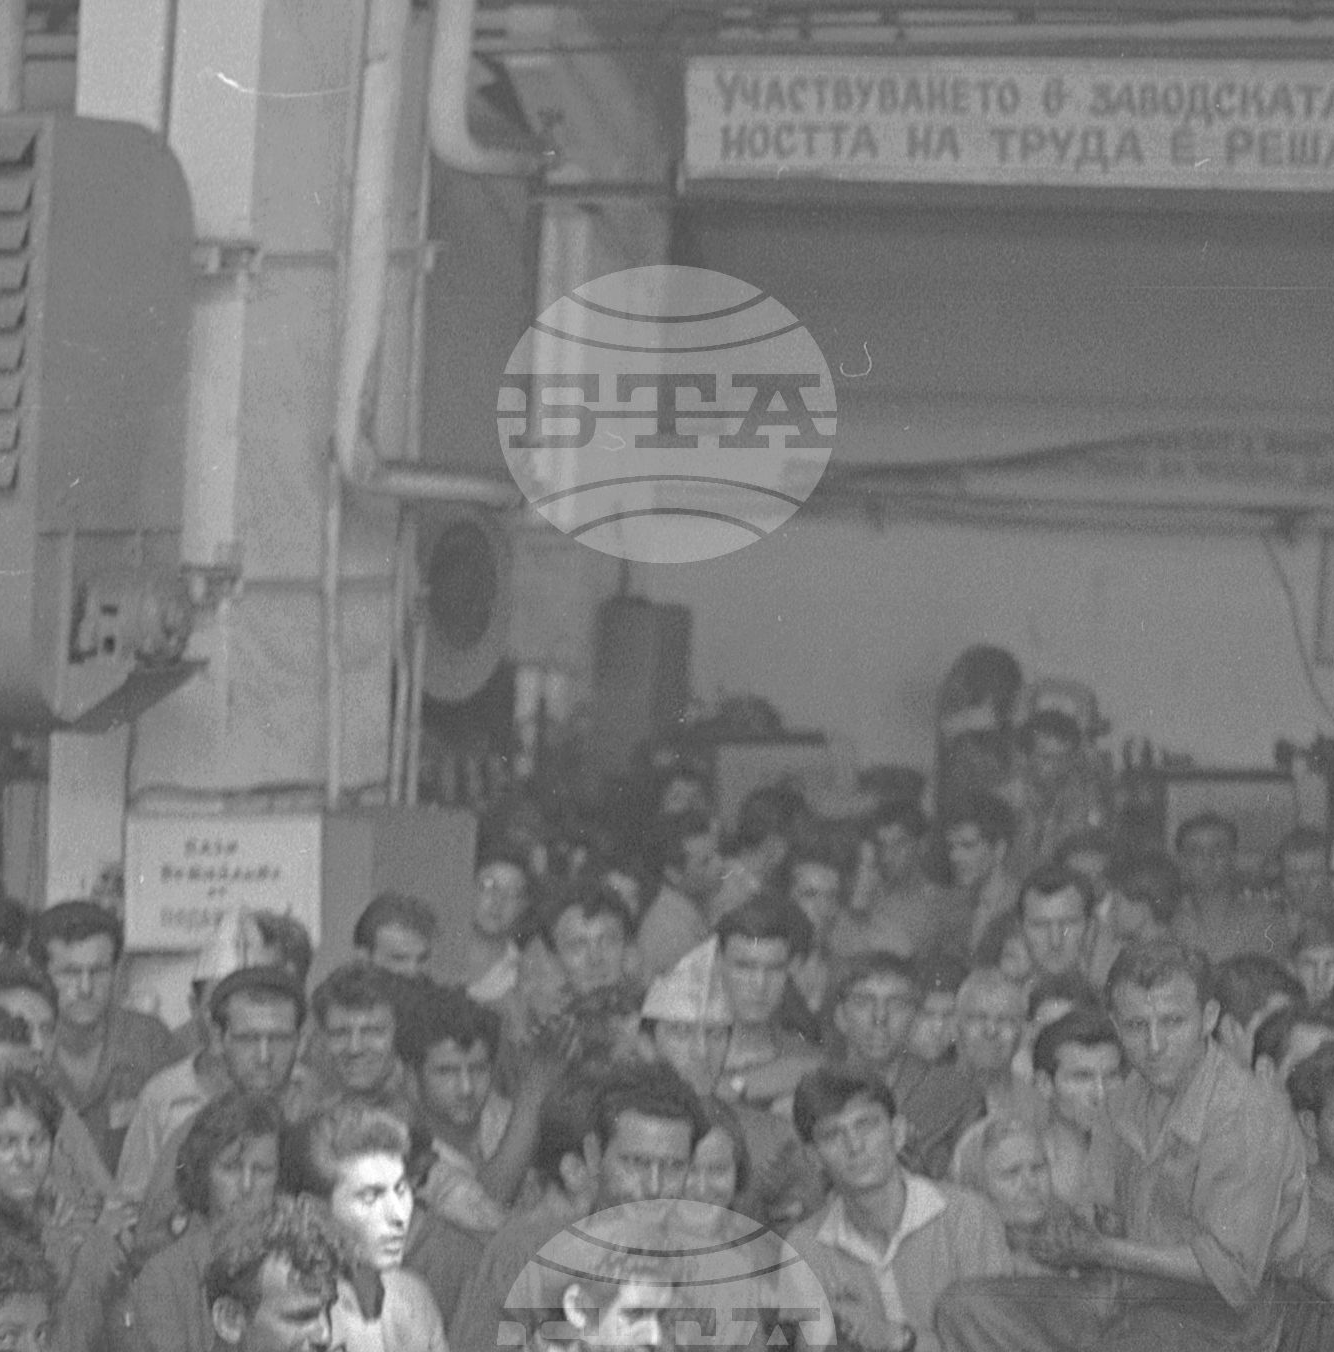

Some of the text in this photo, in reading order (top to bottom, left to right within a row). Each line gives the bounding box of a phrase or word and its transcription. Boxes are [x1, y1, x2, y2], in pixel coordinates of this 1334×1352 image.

[717, 73, 1019, 117] УЧАСТВУВАНЕТО
[720, 122, 879, 160] НОСТТА
[906, 124, 961, 162] НА
[989, 127, 1145, 174] ТРУДА
[1171, 126, 1198, 166] Е
